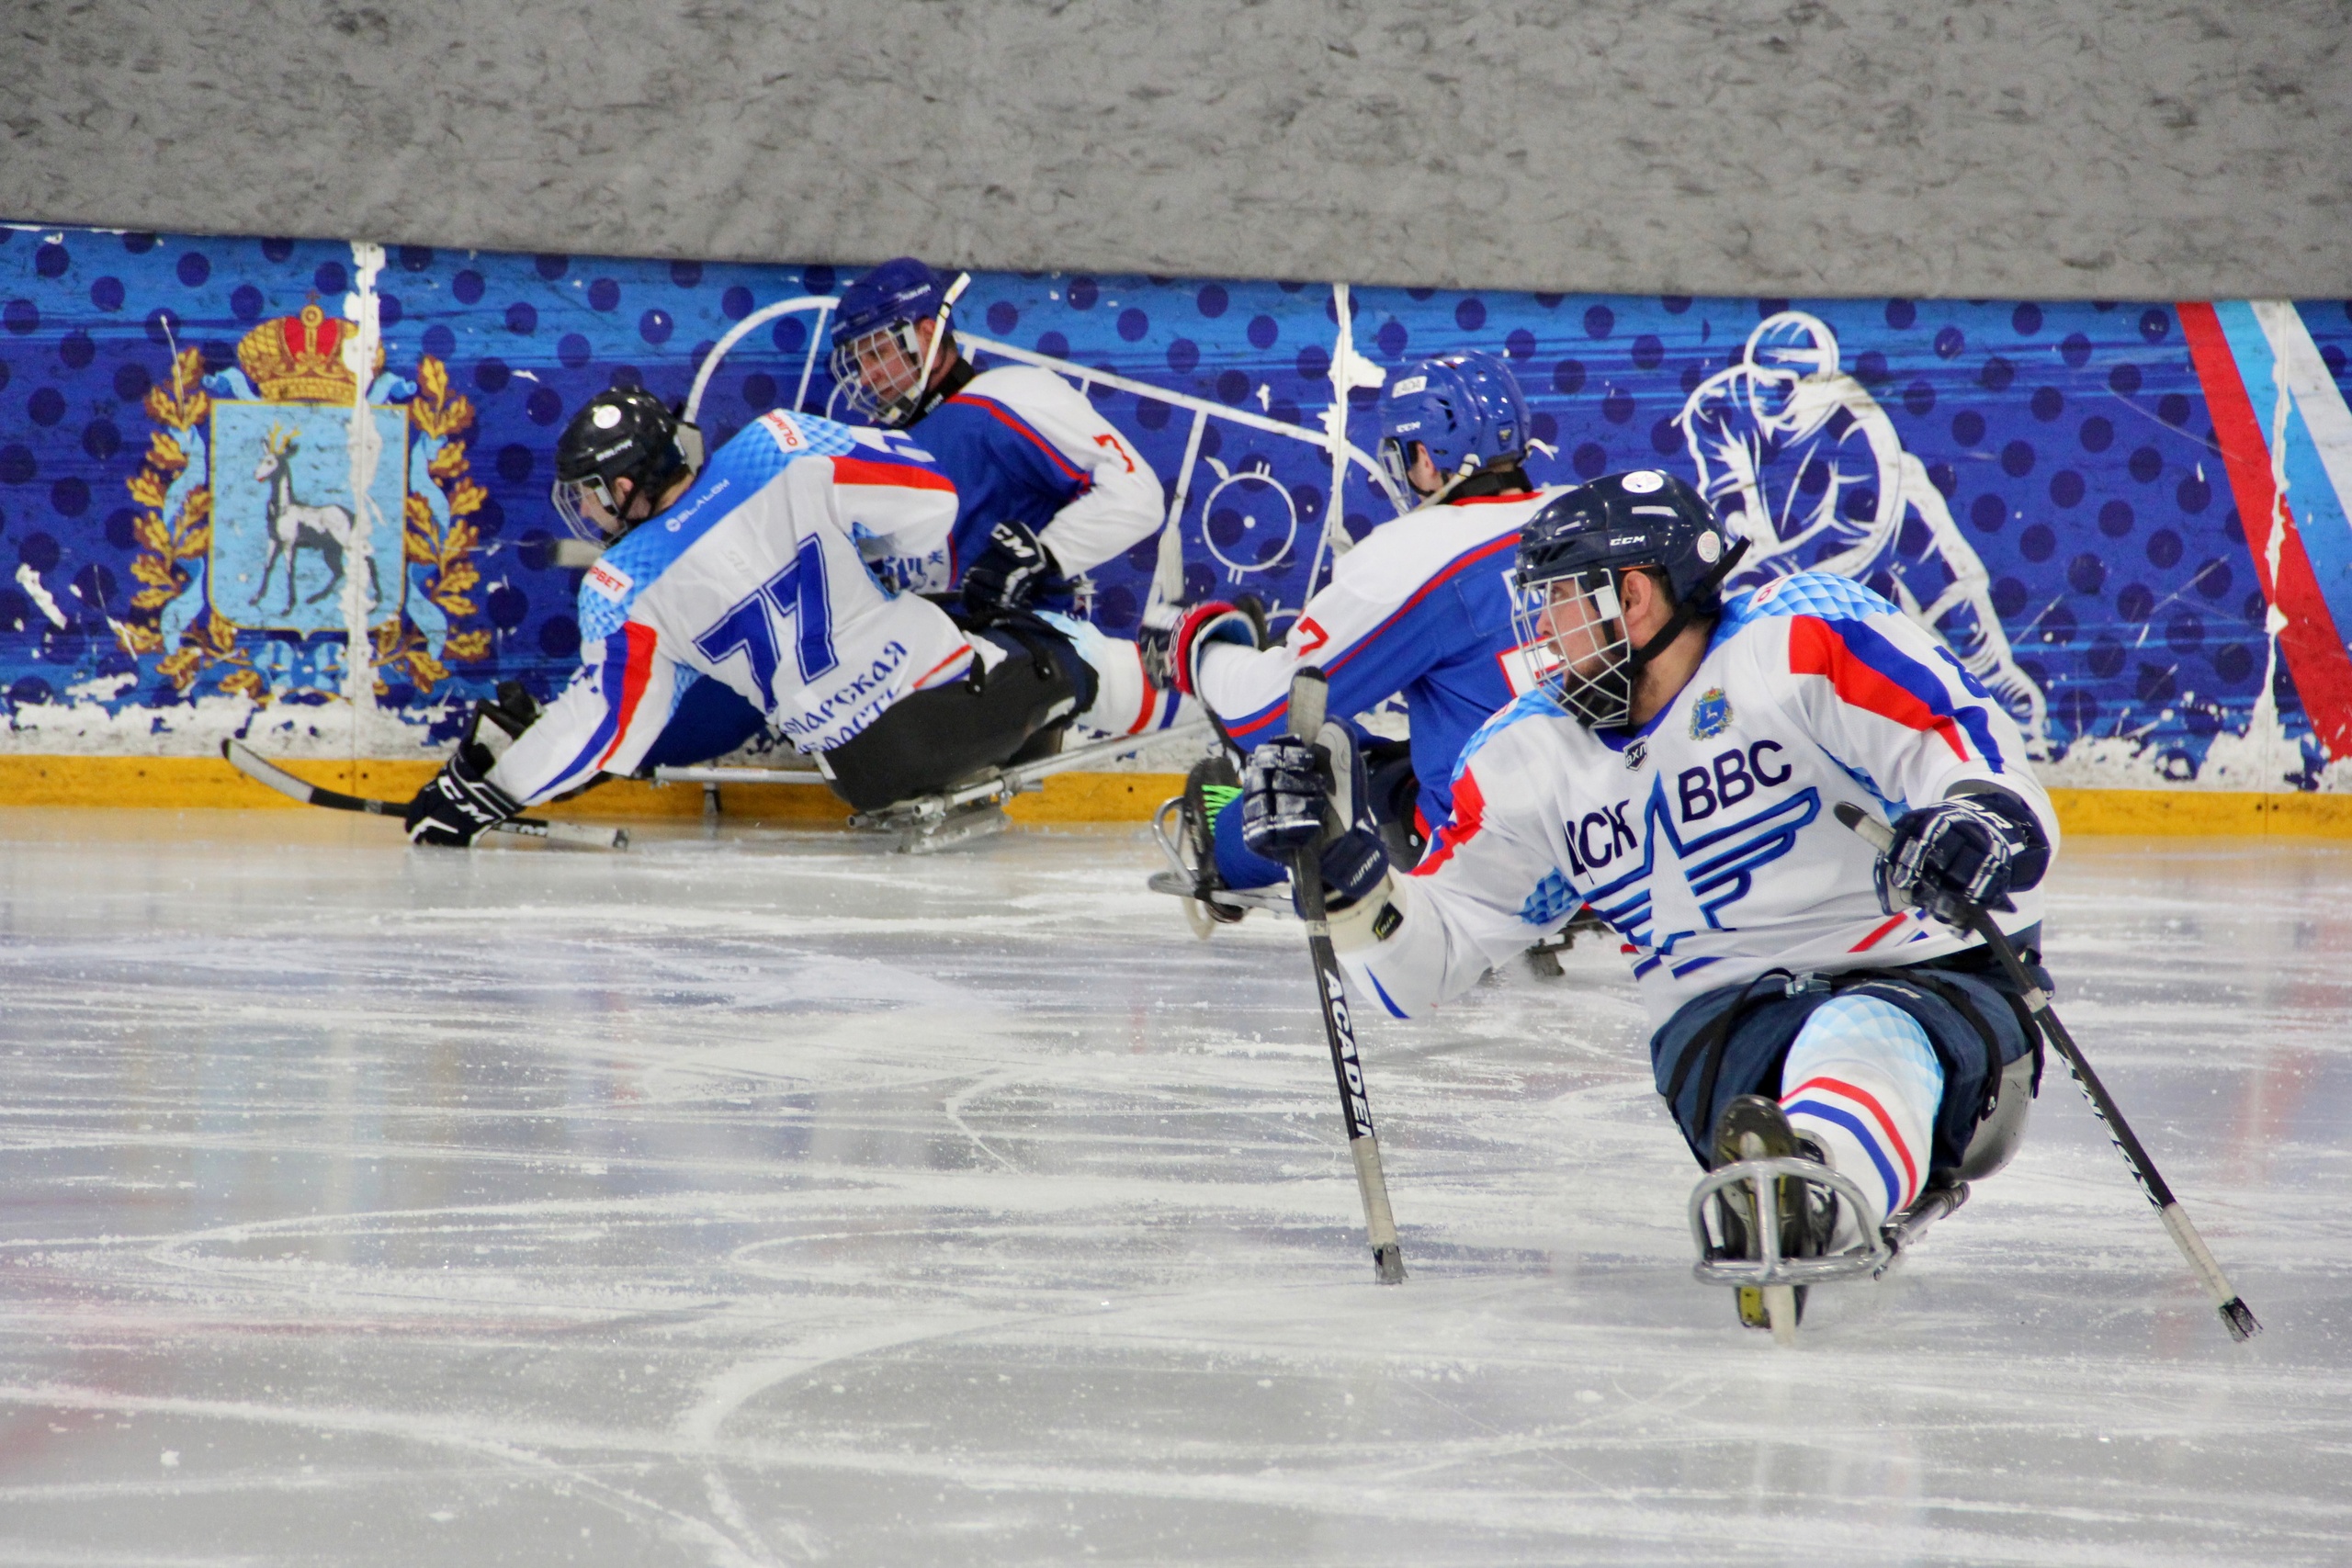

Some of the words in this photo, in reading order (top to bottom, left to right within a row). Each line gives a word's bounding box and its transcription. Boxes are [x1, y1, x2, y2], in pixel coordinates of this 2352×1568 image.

[675, 478, 730, 525] SLALOM
[991, 522, 1035, 558] CM
[1610, 535, 1646, 547] CCM
[692, 532, 840, 716] 77
[1297, 610, 1329, 659] 7
[781, 640, 904, 737] МАРСКАЯ
[436, 774, 496, 823] CM
